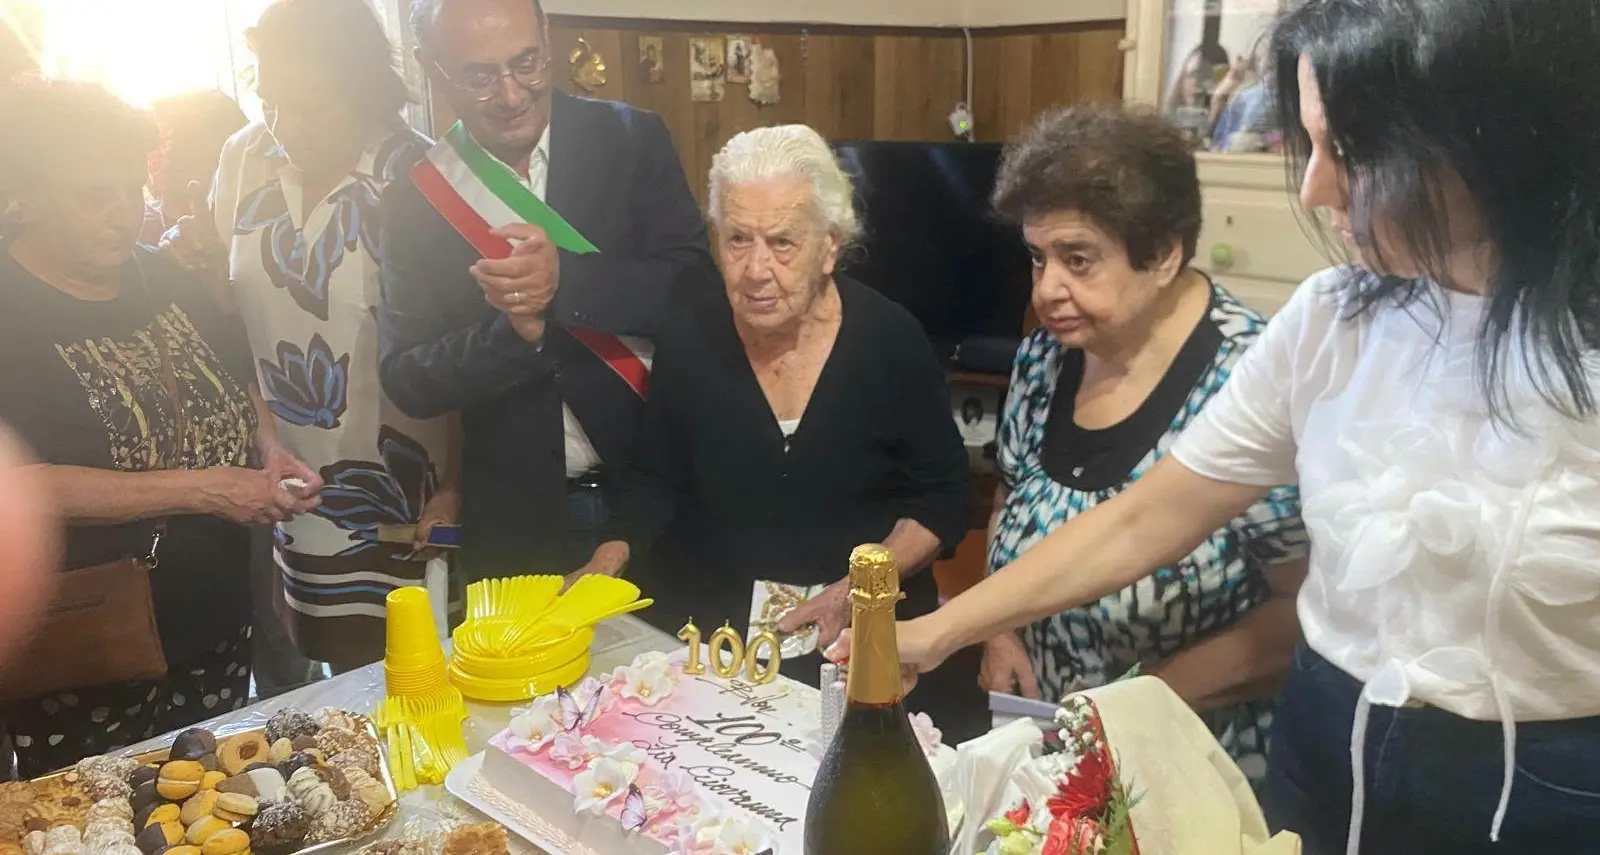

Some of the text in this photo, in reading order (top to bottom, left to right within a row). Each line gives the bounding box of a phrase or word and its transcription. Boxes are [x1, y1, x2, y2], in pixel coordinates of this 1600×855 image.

[677, 620, 782, 684] 100
[622, 711, 811, 790] Compleanno
[631, 737, 678, 770] Zia
